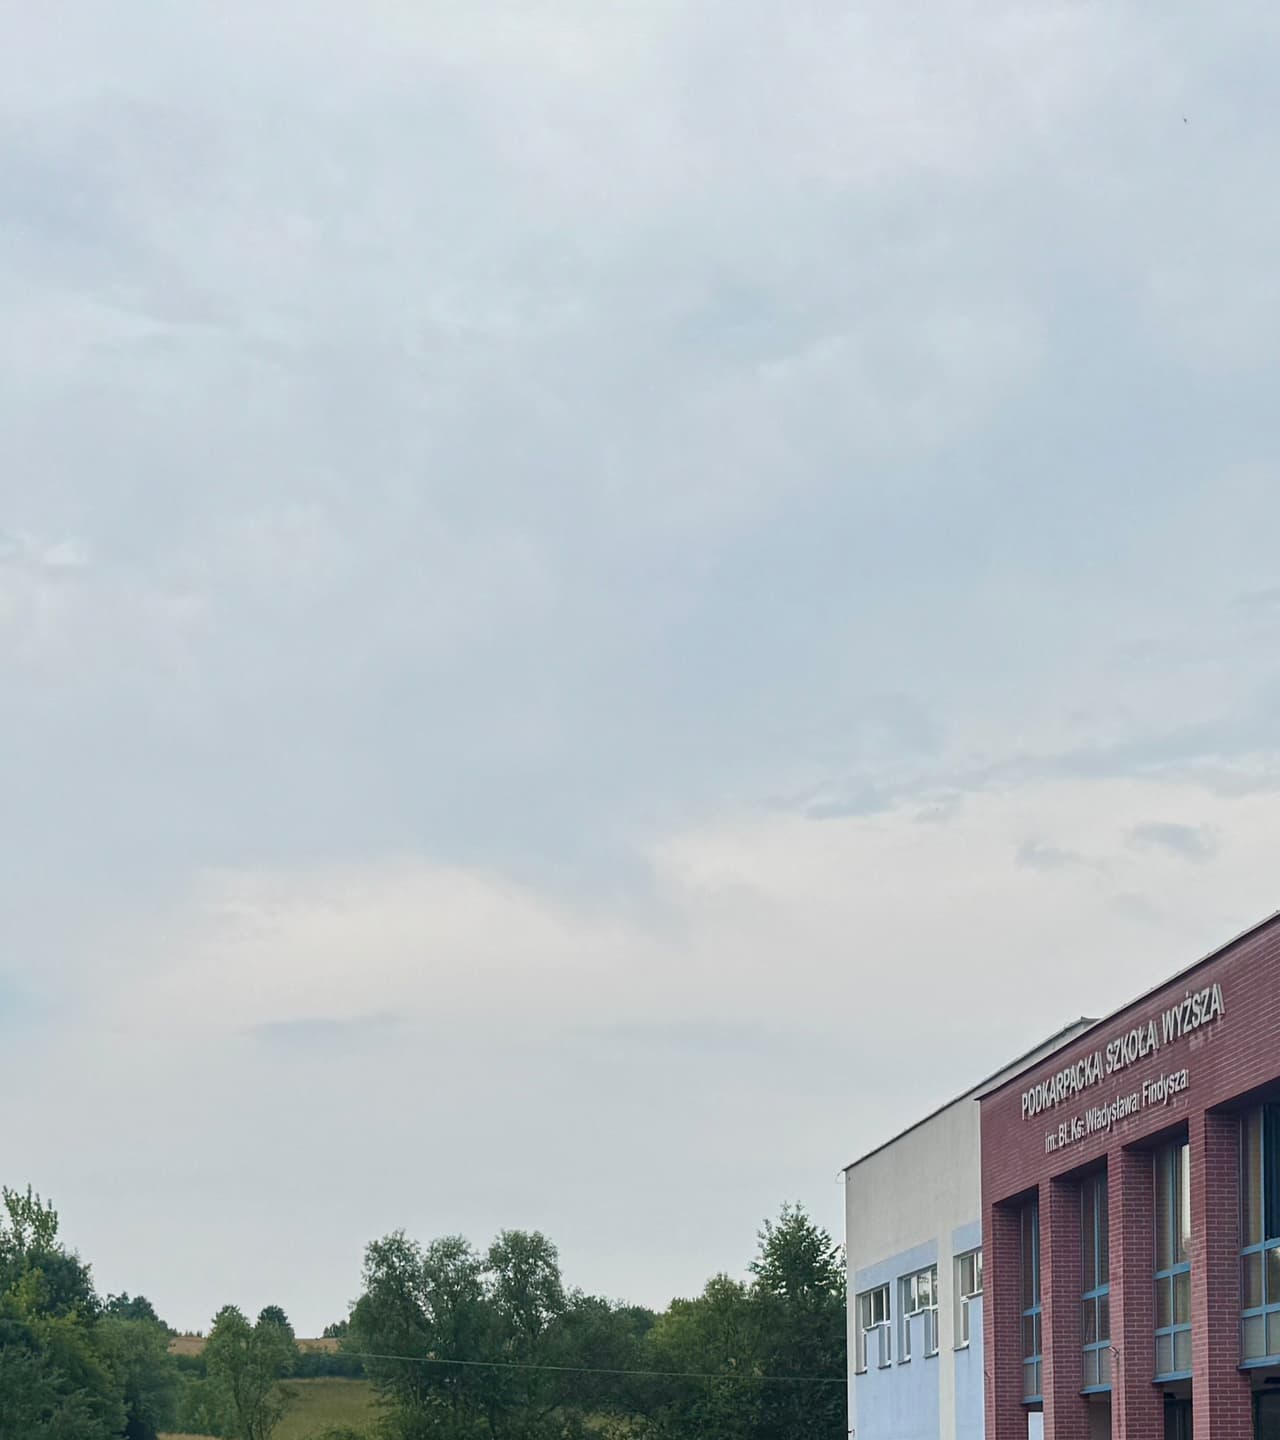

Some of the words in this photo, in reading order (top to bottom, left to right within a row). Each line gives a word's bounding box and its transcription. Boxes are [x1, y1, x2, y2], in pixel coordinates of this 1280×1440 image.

[1022, 1052, 1104, 1120] PODKARPACKA
[1106, 1020, 1160, 1074] SZKOŁA
[1162, 984, 1225, 1043] WYŻSZA
[1086, 1092, 1140, 1132] Władysława
[1142, 1069, 1190, 1107] Findysza
